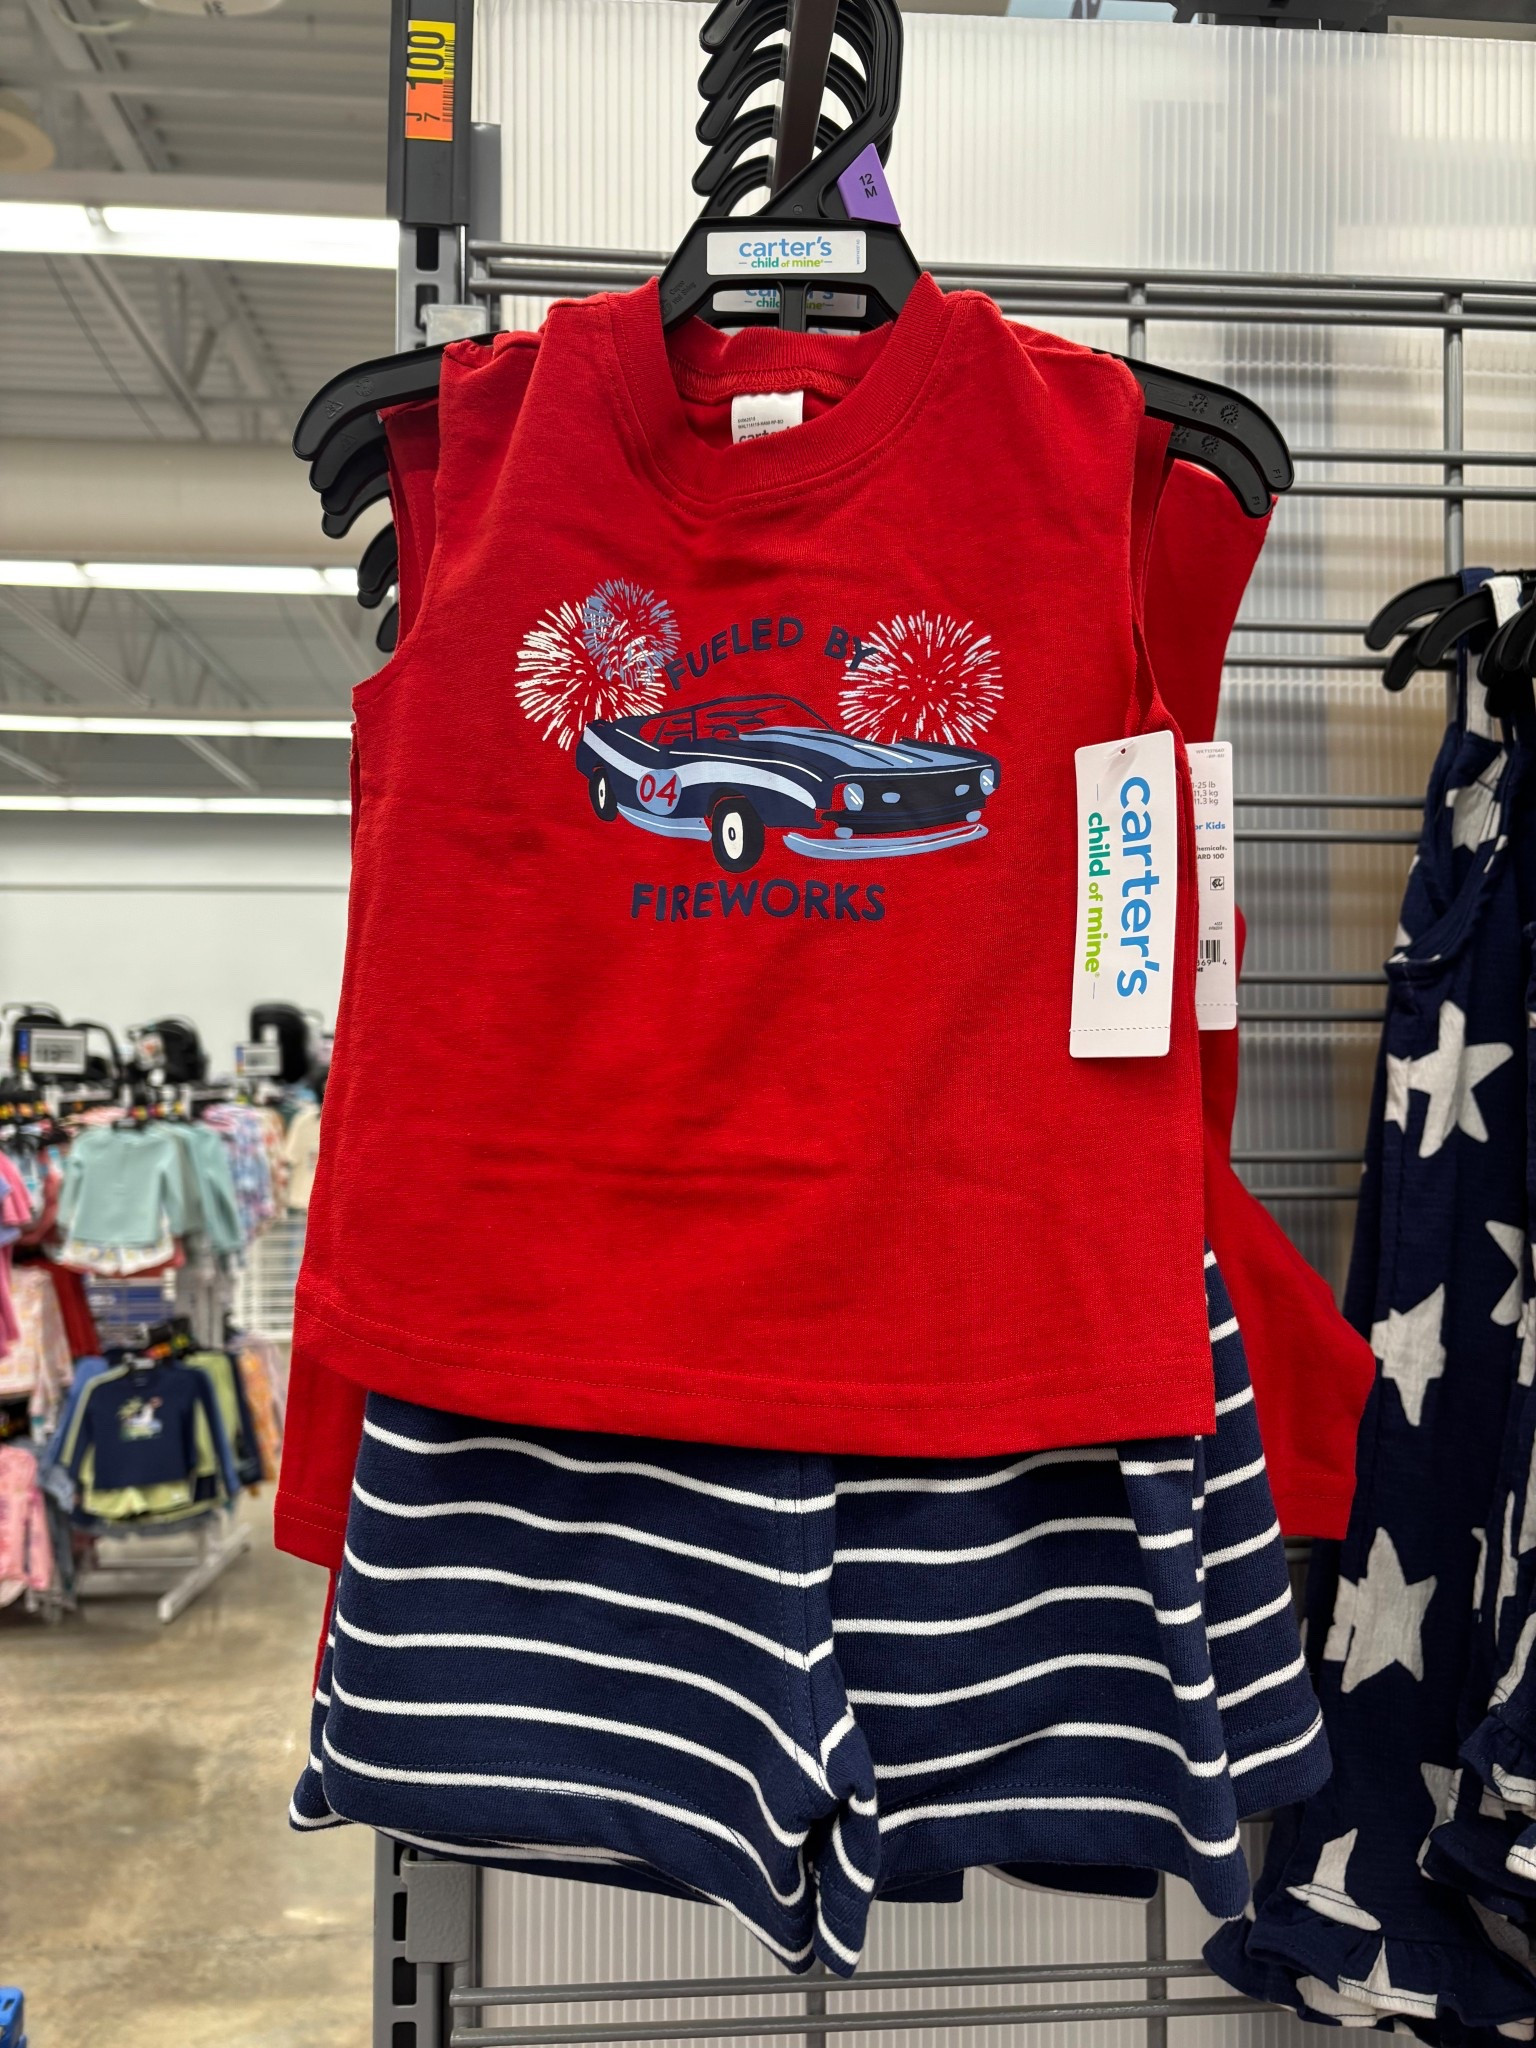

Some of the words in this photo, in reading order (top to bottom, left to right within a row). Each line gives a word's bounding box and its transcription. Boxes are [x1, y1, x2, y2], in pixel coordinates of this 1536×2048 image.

[406, 31, 445, 90] 100
[859, 173, 875, 186] 12
[864, 185, 878, 199] M
[738, 236, 832, 258] carter's
[751, 257, 779, 269] child
[781, 259, 790, 268] of
[664, 616, 804, 691] FUELED
[824, 625, 882, 671] BY
[639, 774, 678, 807] 04
[1208, 780, 1216, 789] lb
[1208, 790, 1219, 798] kg
[1208, 798, 1219, 806] kg
[1205, 821, 1226, 830] Kids
[1088, 812, 1111, 878] child
[1088, 882, 1104, 902] of
[1117, 776, 1160, 998] carter's
[631, 879, 886, 922] FIREWORKS
